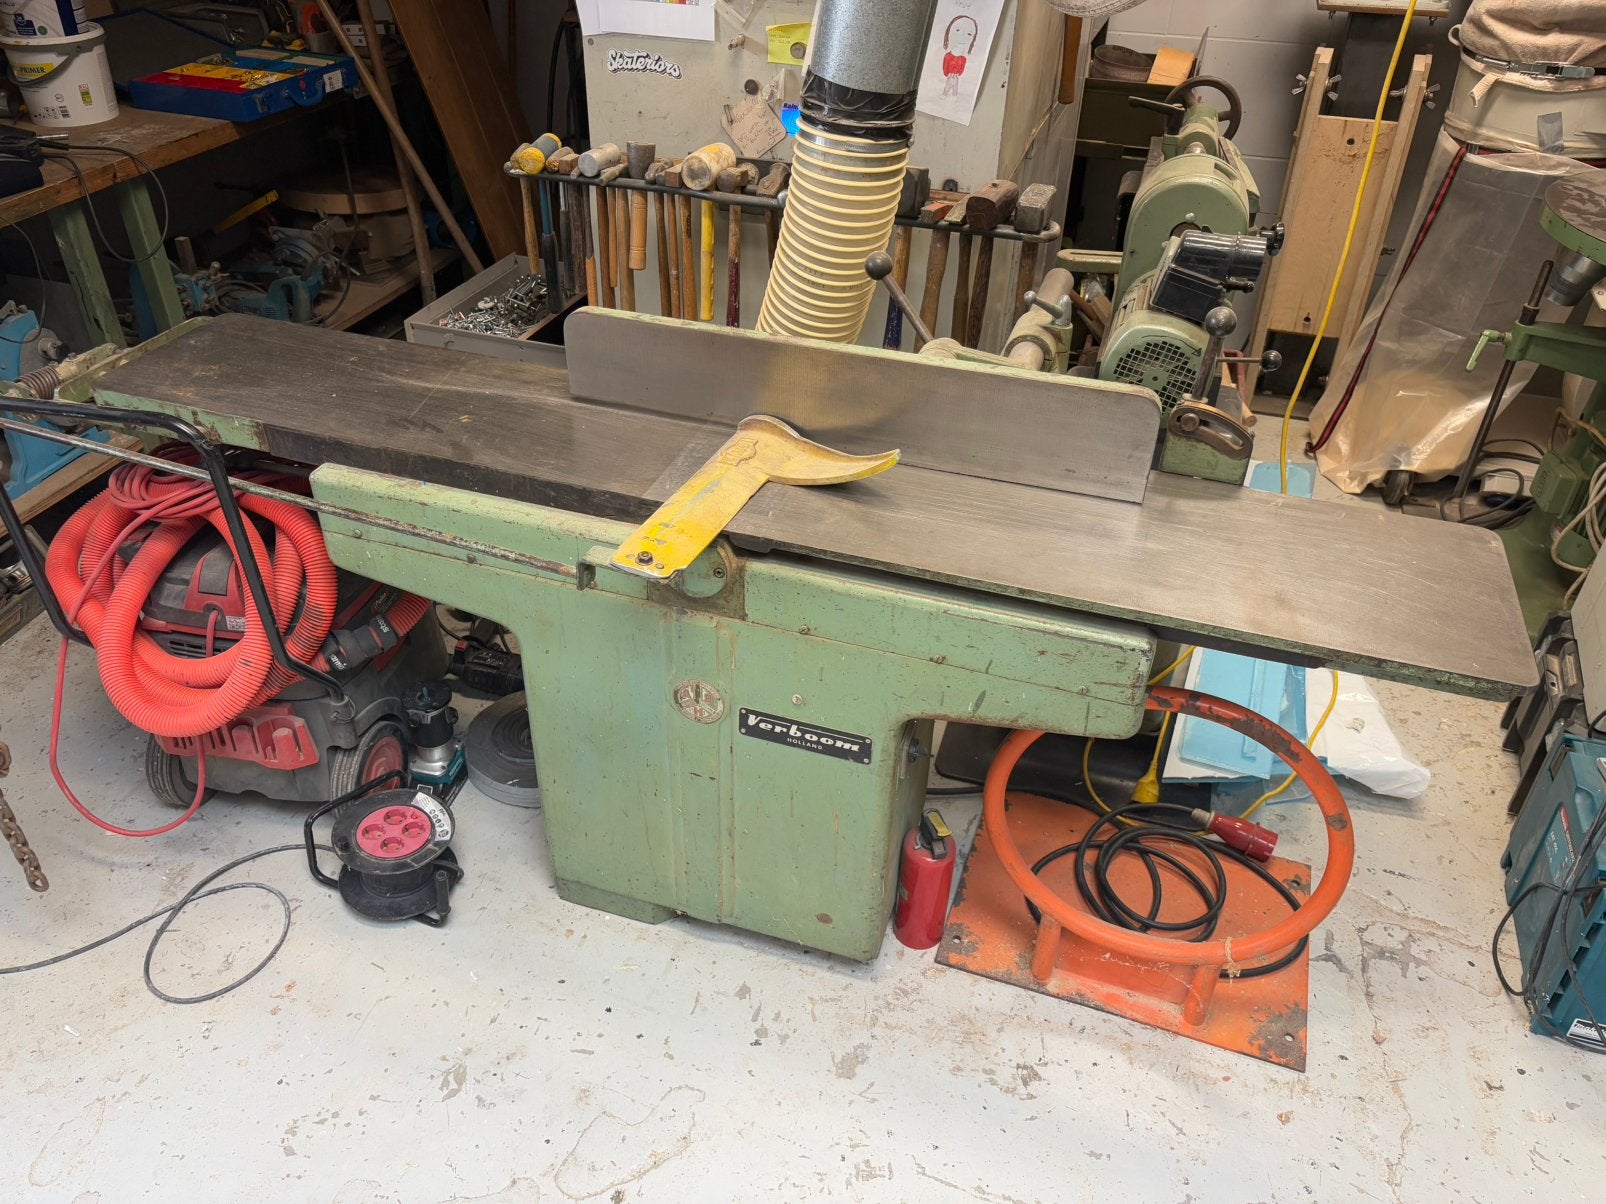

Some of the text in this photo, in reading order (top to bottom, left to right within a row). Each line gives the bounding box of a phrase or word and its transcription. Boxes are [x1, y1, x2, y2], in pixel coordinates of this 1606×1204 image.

[607, 49, 682, 79] Skateriors
[747, 713, 860, 752] Verboom
[787, 737, 823, 750] HOLLAND
